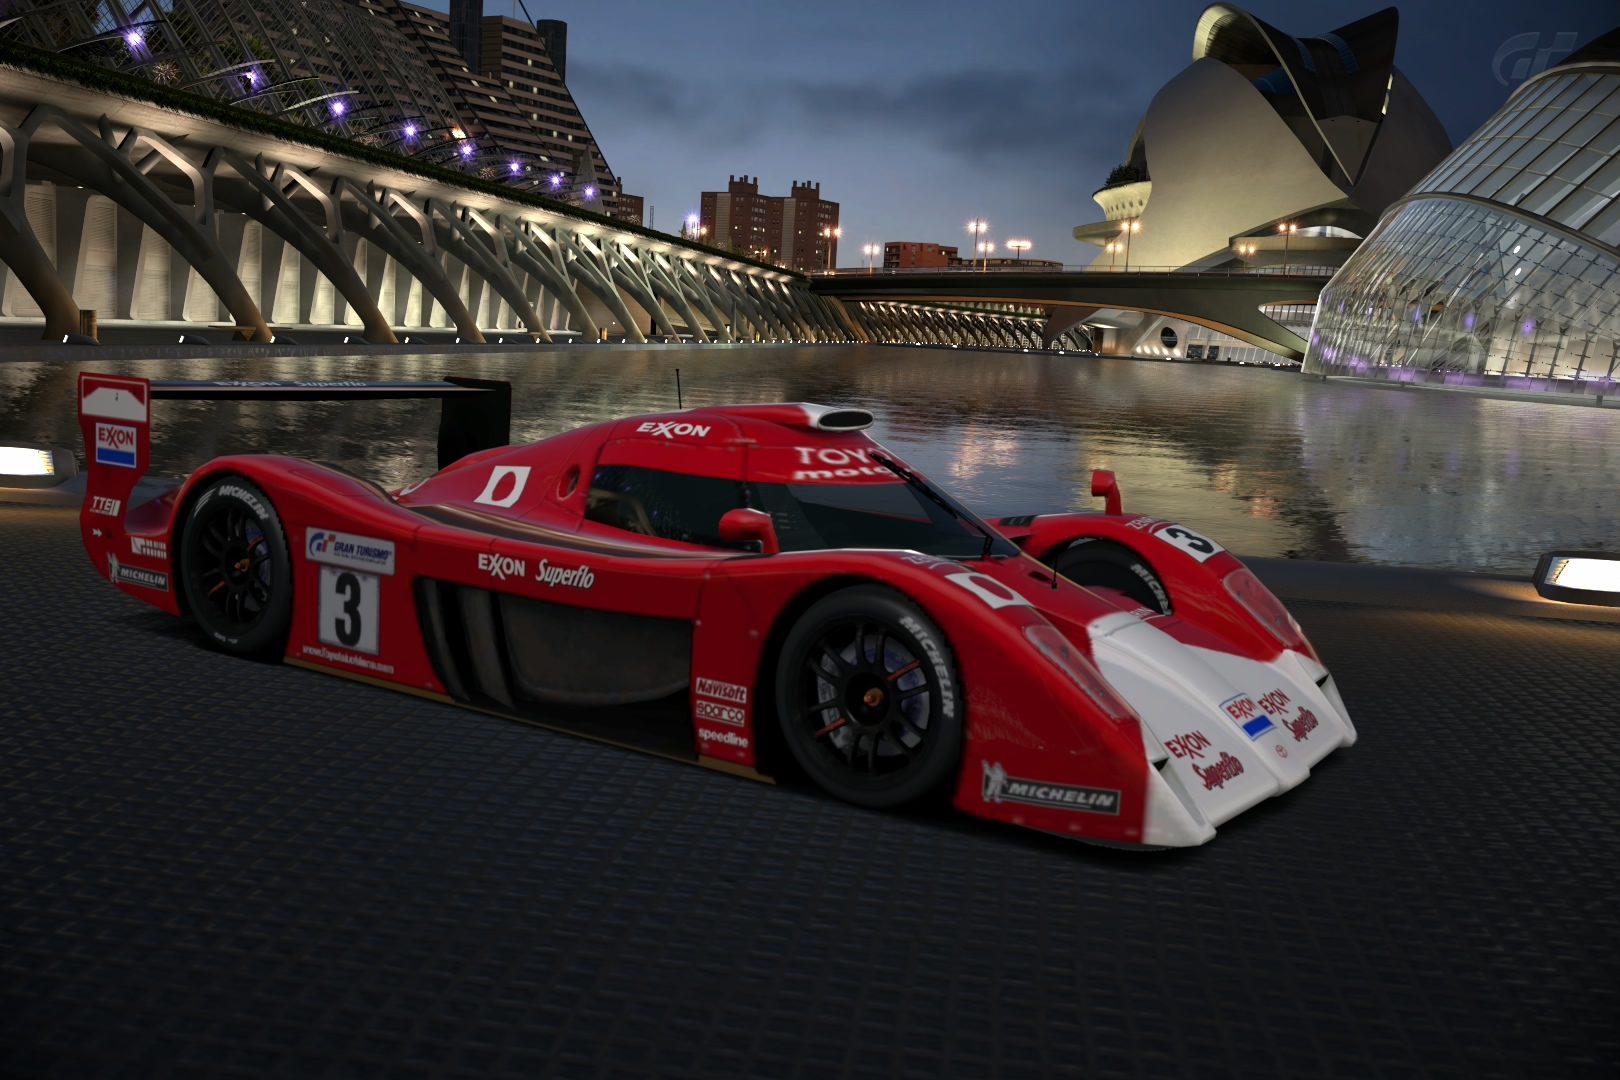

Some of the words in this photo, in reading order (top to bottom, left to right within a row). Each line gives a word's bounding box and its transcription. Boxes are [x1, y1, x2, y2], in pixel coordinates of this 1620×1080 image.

[98, 427, 134, 449] EXXON
[636, 421, 711, 439] EXXON
[218, 485, 270, 520] MICHELIN
[334, 541, 355, 554] GRAN
[356, 544, 389, 561] TURISMO
[1165, 527, 1215, 554] 3
[121, 567, 165, 585] MICHELIN
[477, 553, 526, 580] EXXON
[535, 558, 595, 589] Superflo
[335, 572, 362, 647] 3
[899, 616, 955, 718] MICHELIN
[697, 679, 746, 701] Navisoft
[1257, 688, 1291, 715] EXXON
[1226, 697, 1258, 719] EXXON
[698, 727, 749, 747] speedline
[1281, 705, 1319, 742] Superflo
[1164, 730, 1212, 759] EXXON
[1192, 751, 1245, 791] Superflo
[1008, 782, 1114, 807] MICHELIN
